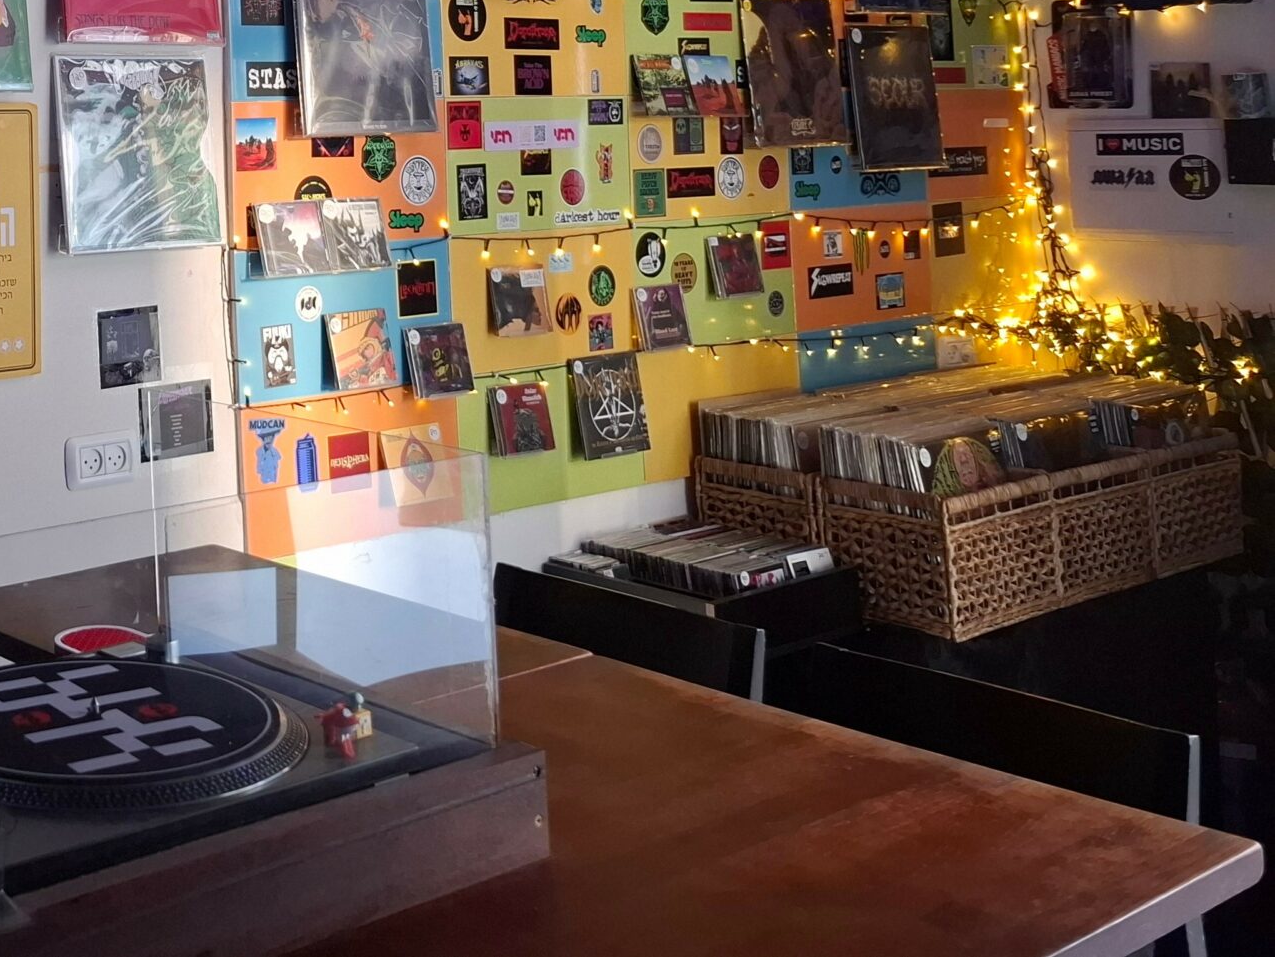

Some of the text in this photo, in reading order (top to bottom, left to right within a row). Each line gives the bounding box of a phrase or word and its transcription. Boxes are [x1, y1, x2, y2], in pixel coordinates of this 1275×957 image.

[1098, 137, 1182, 152] I MUSIC
[388, 210, 424, 233] Sleep
[555, 209, 620, 224] darkest hour
[0, 291, 13, 300] הכי
[249, 419, 285, 431] MUDCAN
